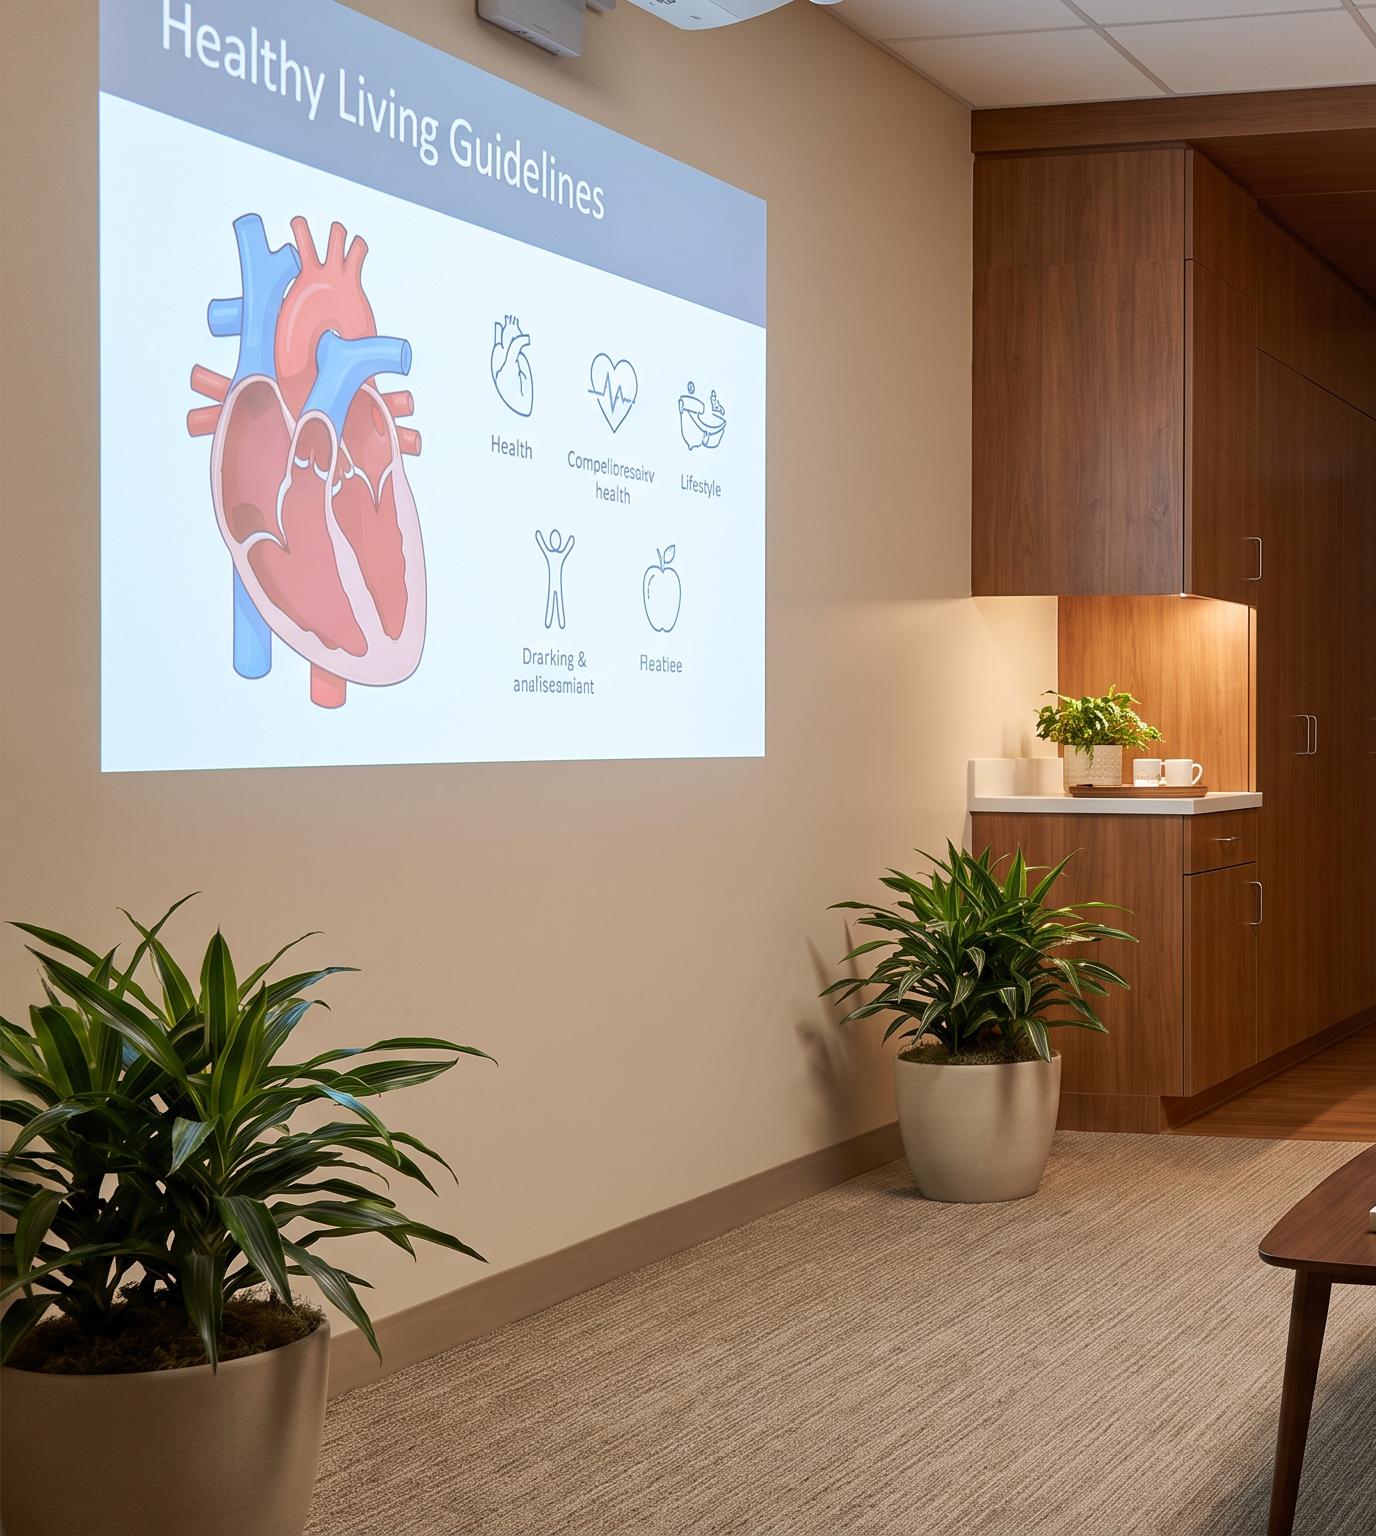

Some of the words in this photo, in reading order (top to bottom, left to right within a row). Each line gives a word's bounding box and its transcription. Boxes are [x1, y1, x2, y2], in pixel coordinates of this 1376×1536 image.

[162, 0, 326, 121] Healthy
[339, 67, 439, 166] Living
[448, 118, 606, 220] Guidelines
[491, 434, 533, 460] Health
[595, 481, 631, 504] health
[680, 473, 722, 499] Lifestyle
[577, 650, 588, 668] &
